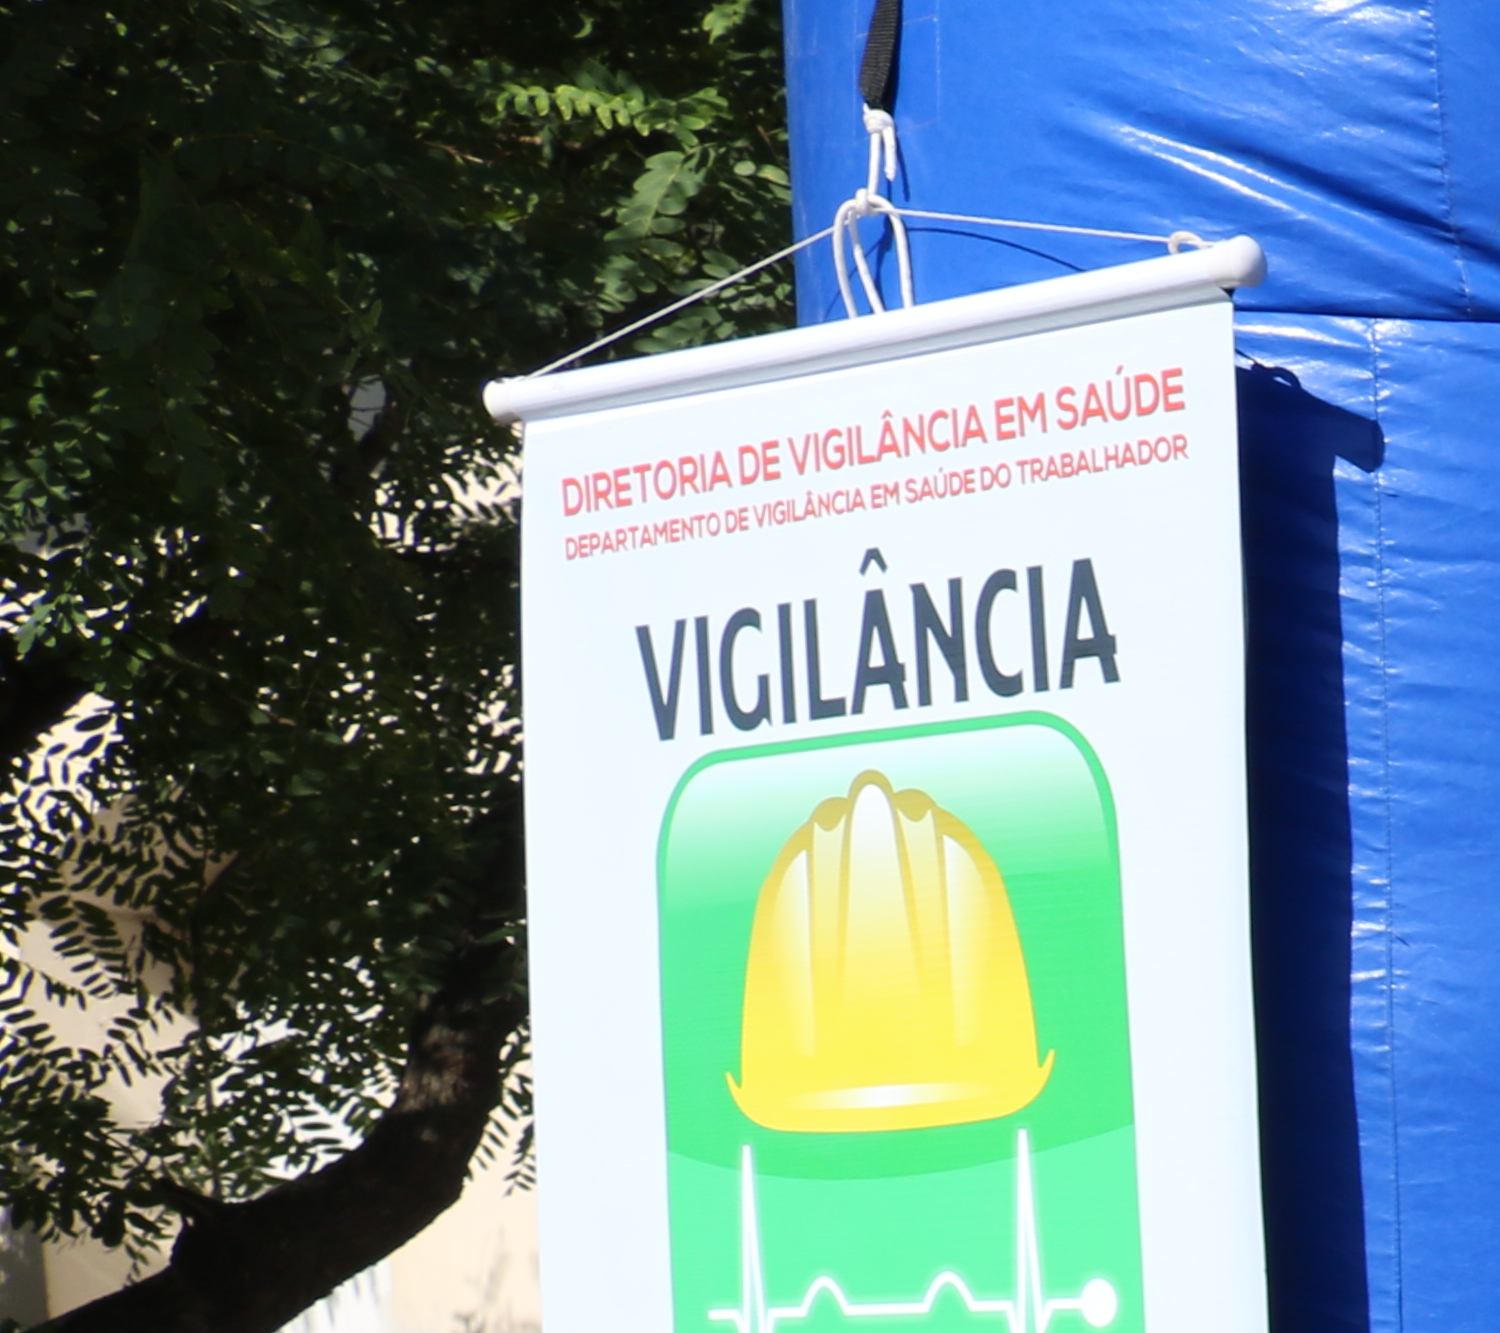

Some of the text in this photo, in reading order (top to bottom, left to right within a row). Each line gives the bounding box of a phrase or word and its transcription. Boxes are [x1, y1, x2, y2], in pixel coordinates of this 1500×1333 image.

[561, 365, 1188, 516] DIRETORIA DE VIGILÂNCIA EM SAÚDE
[565, 433, 1189, 560] DEPARTAMENTO DE VIGILÂNCIA EM SAÚDE DO TRABALHADOR
[634, 546, 1122, 742] VIGILÂNCIA
